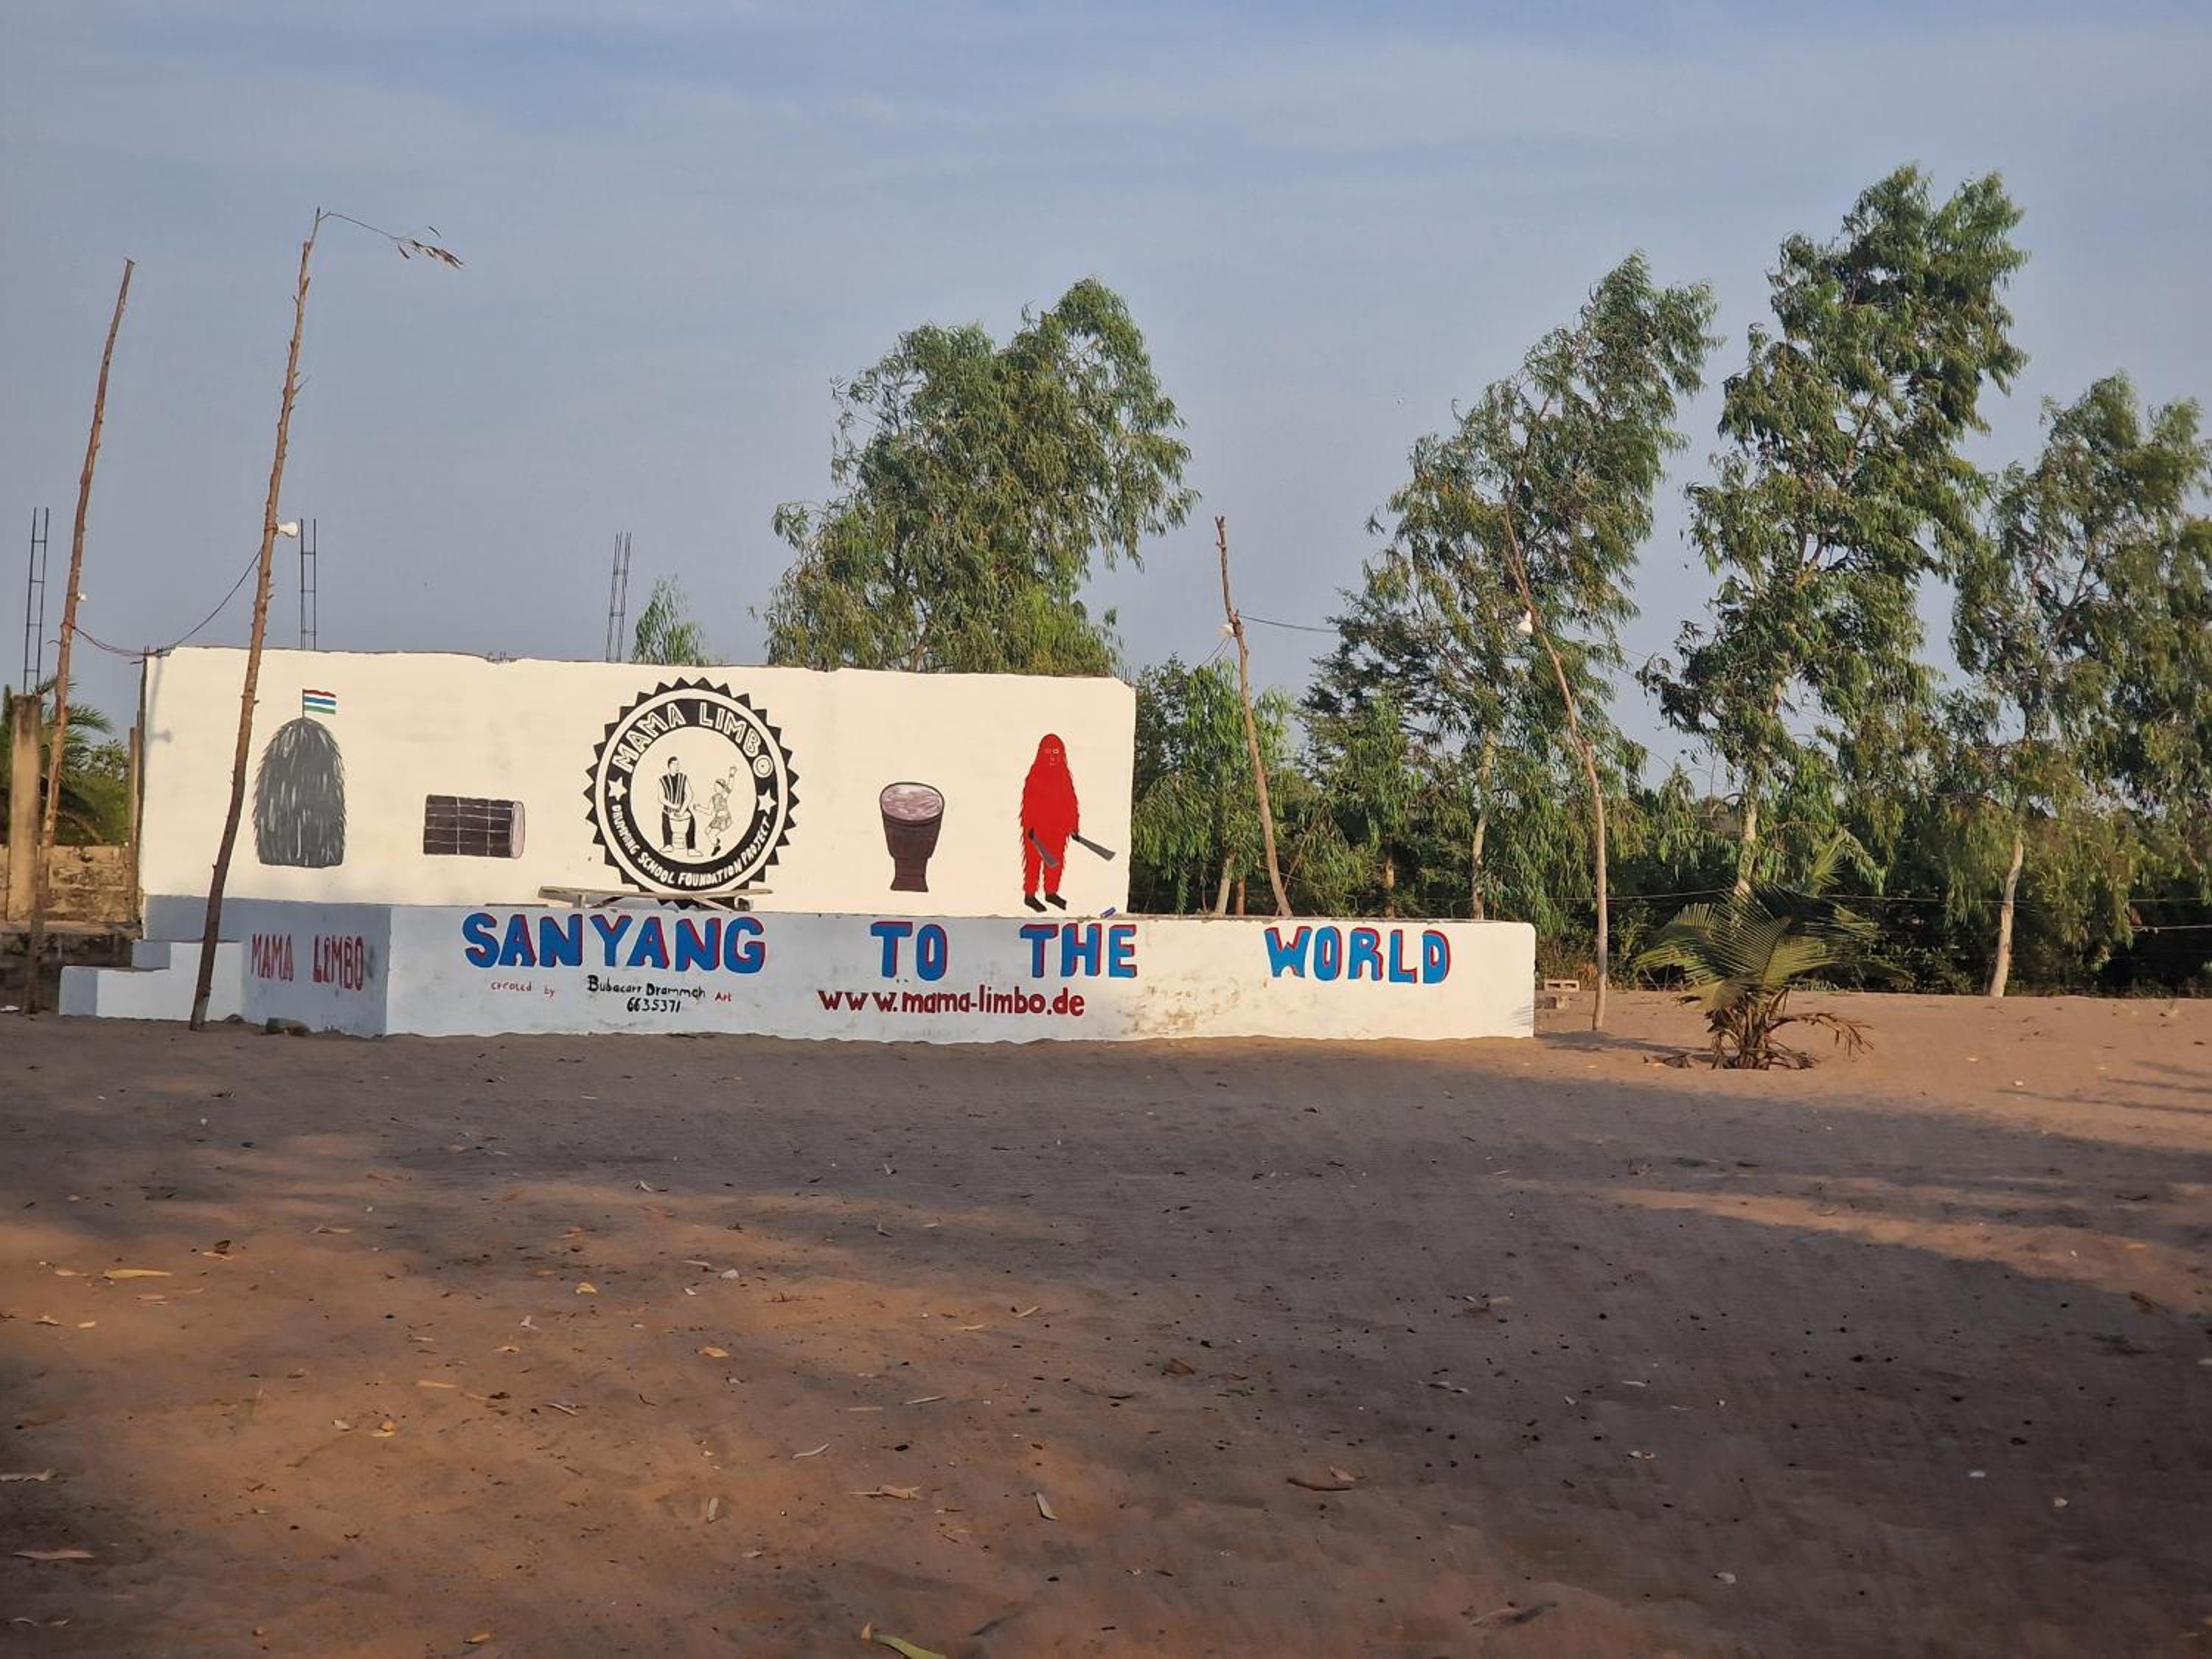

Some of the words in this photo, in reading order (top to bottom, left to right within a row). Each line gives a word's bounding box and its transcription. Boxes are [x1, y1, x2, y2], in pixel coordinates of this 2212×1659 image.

[612, 703, 686, 773] MAMA
[699, 702, 773, 778] LIMBO
[637, 852, 675, 884] SCHOOL
[678, 859, 742, 886] FOUNDATION
[740, 815, 771, 866] PROJECT
[251, 933, 294, 982] MAMA
[313, 934, 364, 992] LIMBO
[462, 911, 767, 974] SANYANG
[870, 920, 948, 981] TO
[1020, 922, 1138, 978] THE
[1264, 925, 1452, 984] WORLD
[587, 974, 643, 993] Bubacarr
[714, 991, 732, 1002] Art
[626, 996, 682, 1013] 6635371
[818, 984, 1085, 1017] www.mama-limbo.de
